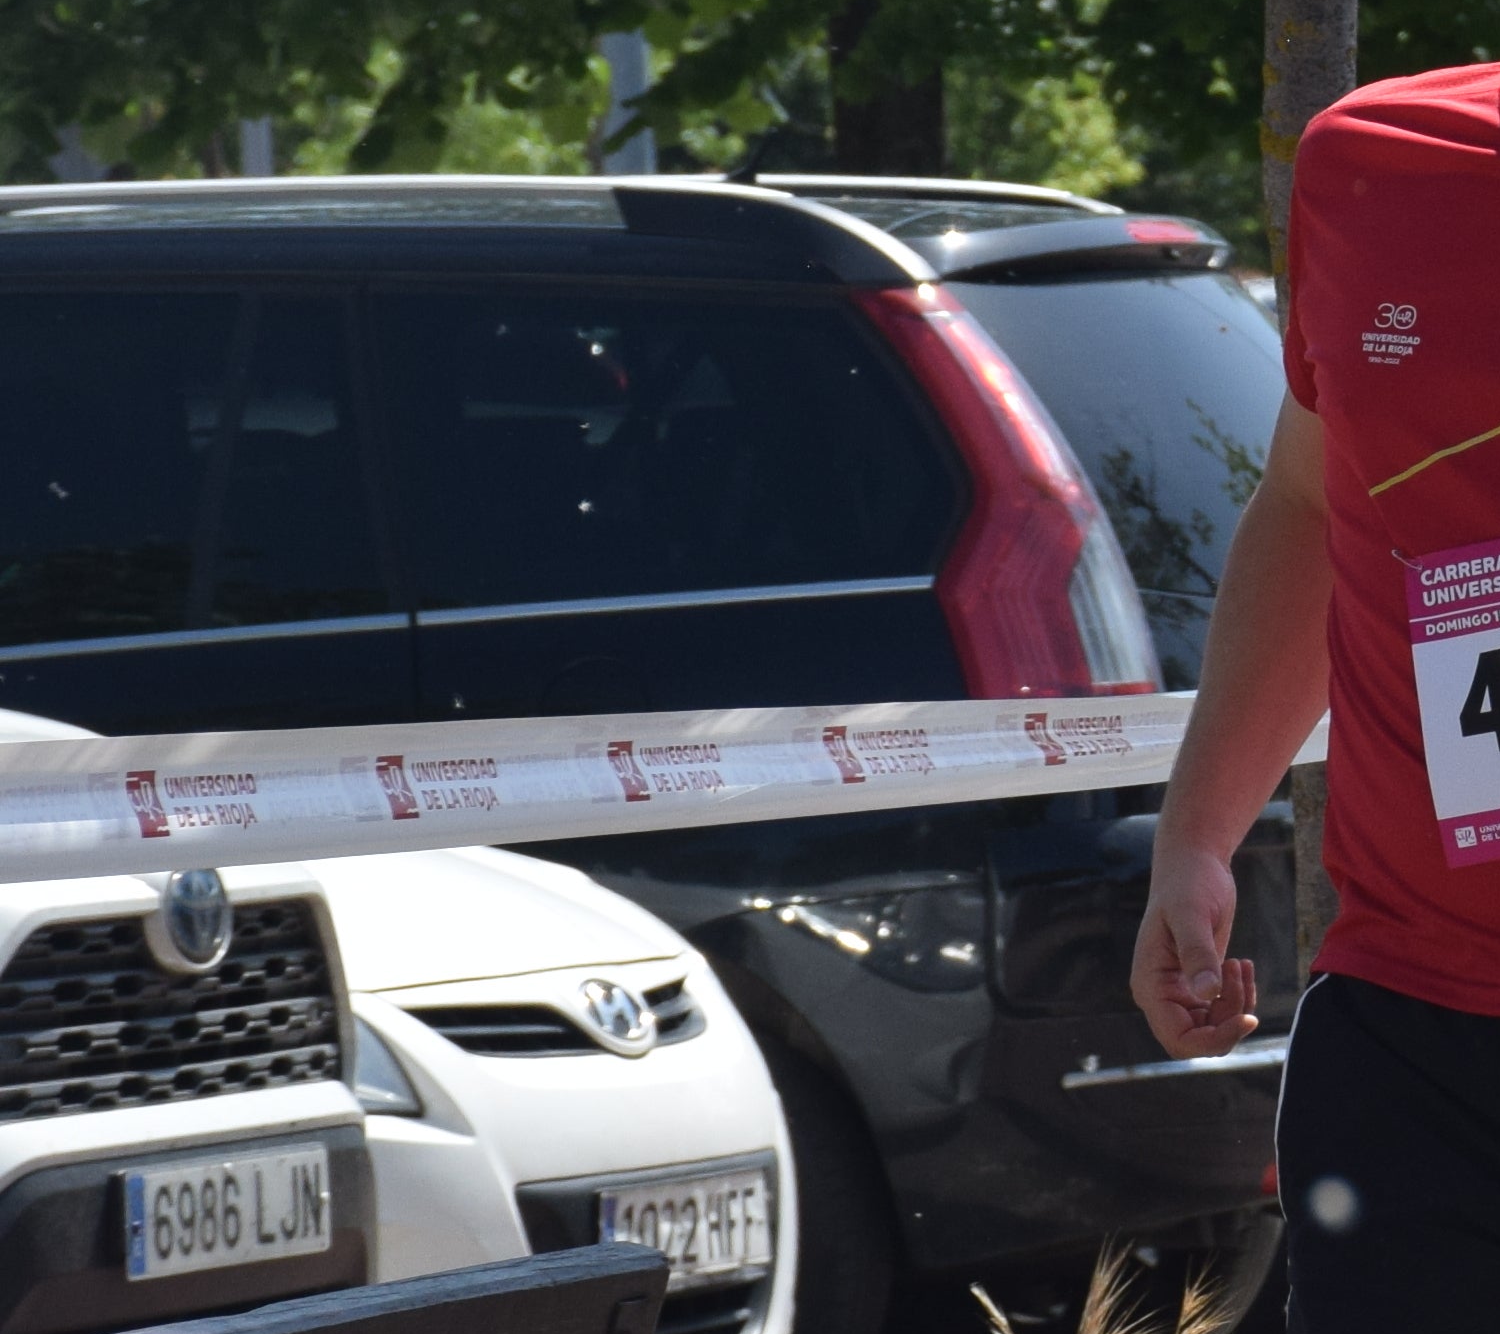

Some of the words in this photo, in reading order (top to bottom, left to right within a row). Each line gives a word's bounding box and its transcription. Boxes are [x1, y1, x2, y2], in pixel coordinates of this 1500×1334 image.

[1375, 303, 1417, 329] 30
[1362, 332, 1420, 345] UNIVERSIDAD
[1363, 343, 1373, 352] DE
[1374, 344, 1385, 353] LA
[1387, 344, 1413, 355] RIOJA
[1426, 613, 1490, 636] DOMINGO
[852, 729, 929, 750] UNIVERSIDAD
[640, 744, 720, 766] UNIVERSIDAD
[866, 756, 881, 774] DE
[886, 755, 898, 773] LA
[900, 753, 934, 774] RIOJA
[411, 758, 498, 782] UNIVERSIDAD
[655, 773, 672, 792] DE
[675, 773, 687, 790] LA
[689, 769, 725, 792] RIOJA
[164, 774, 257, 798] UNIVERSIDAD
[422, 789, 442, 809] DE
[446, 789, 461, 808] LA
[463, 787, 500, 810] RIOJA
[174, 806, 196, 827] DE
[199, 806, 216, 826] LA
[219, 803, 258, 829] RIOJA
[1481, 834, 1494, 842] DE
[154, 1172, 240, 1260] 6986
[255, 1163, 322, 1243] LJN
